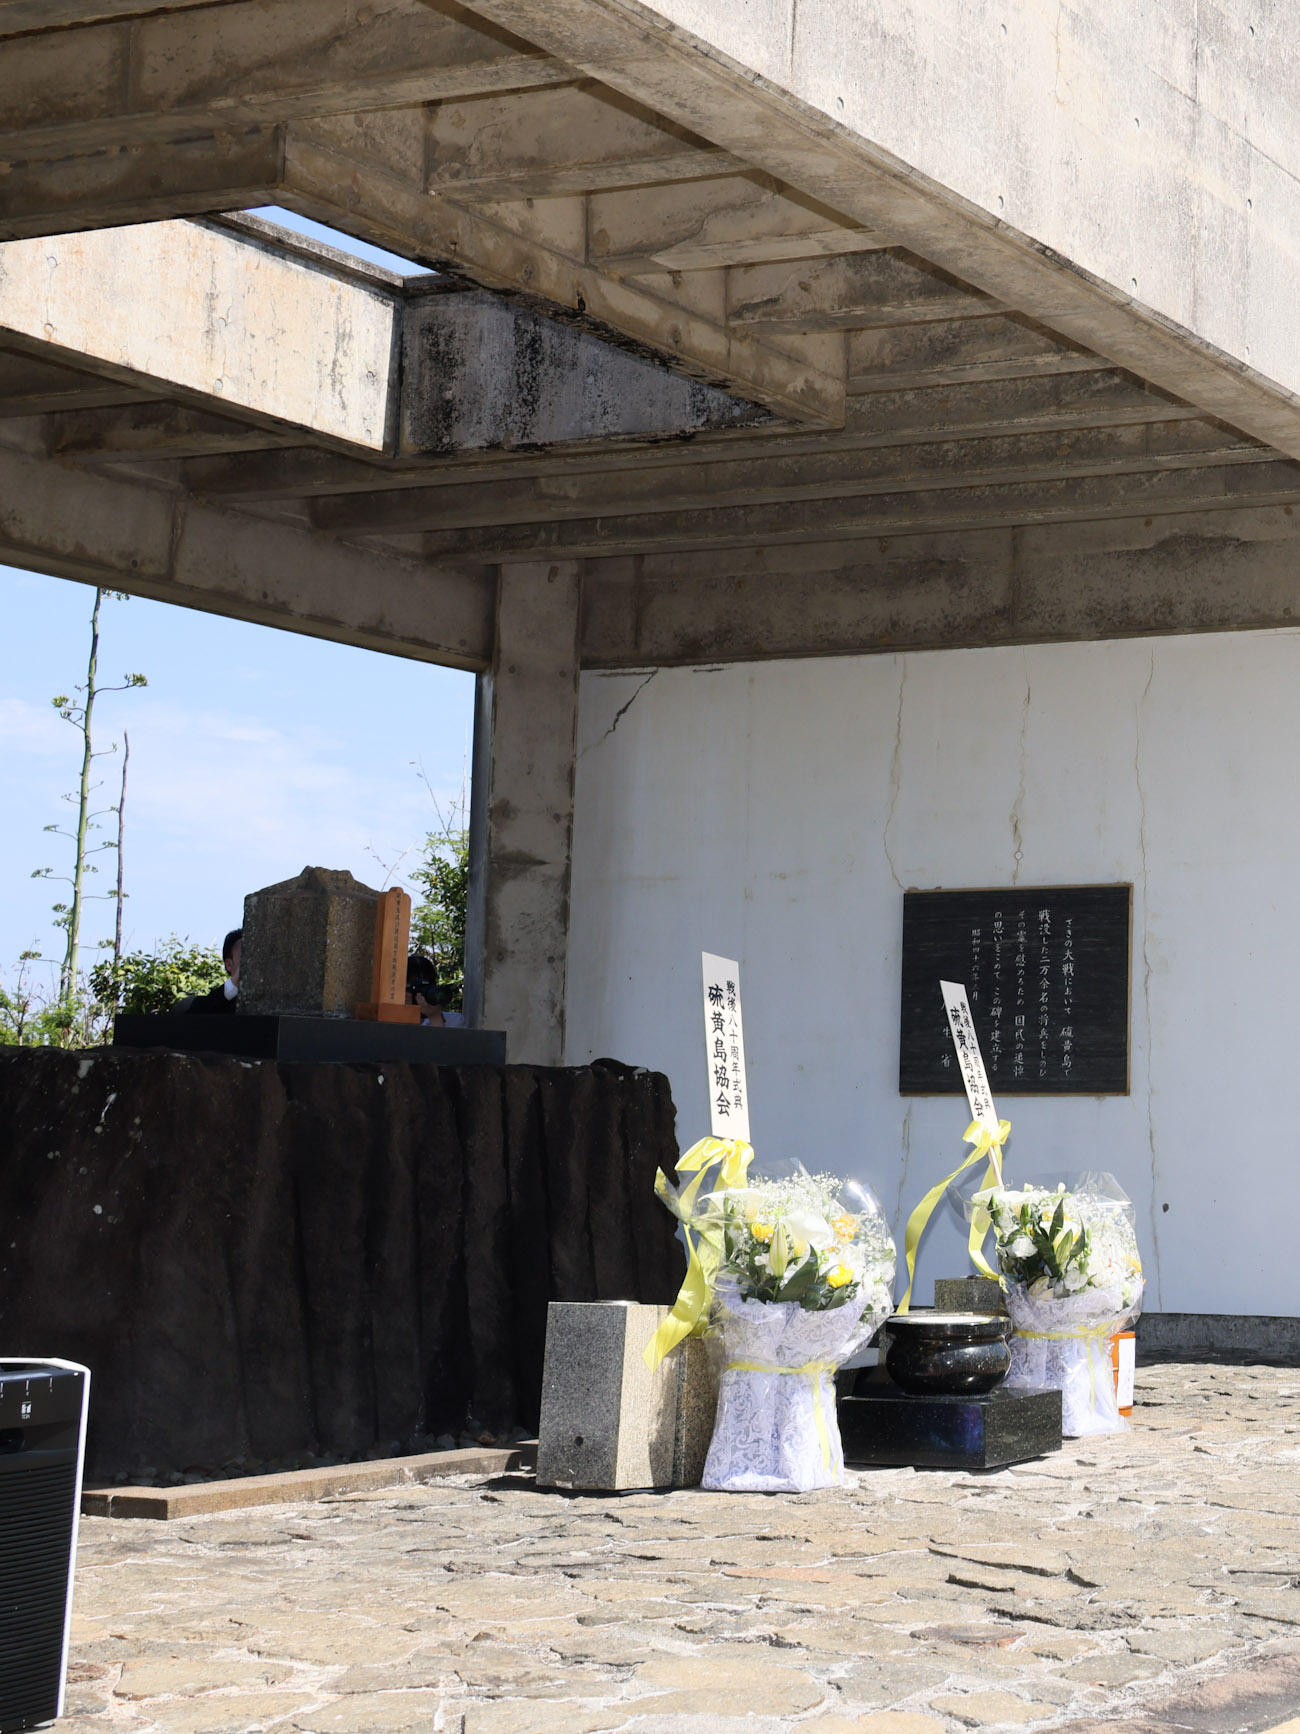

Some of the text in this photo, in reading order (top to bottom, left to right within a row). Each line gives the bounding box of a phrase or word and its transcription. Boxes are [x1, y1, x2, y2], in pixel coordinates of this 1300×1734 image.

[708, 984, 730, 1117] 硫黄島協会
